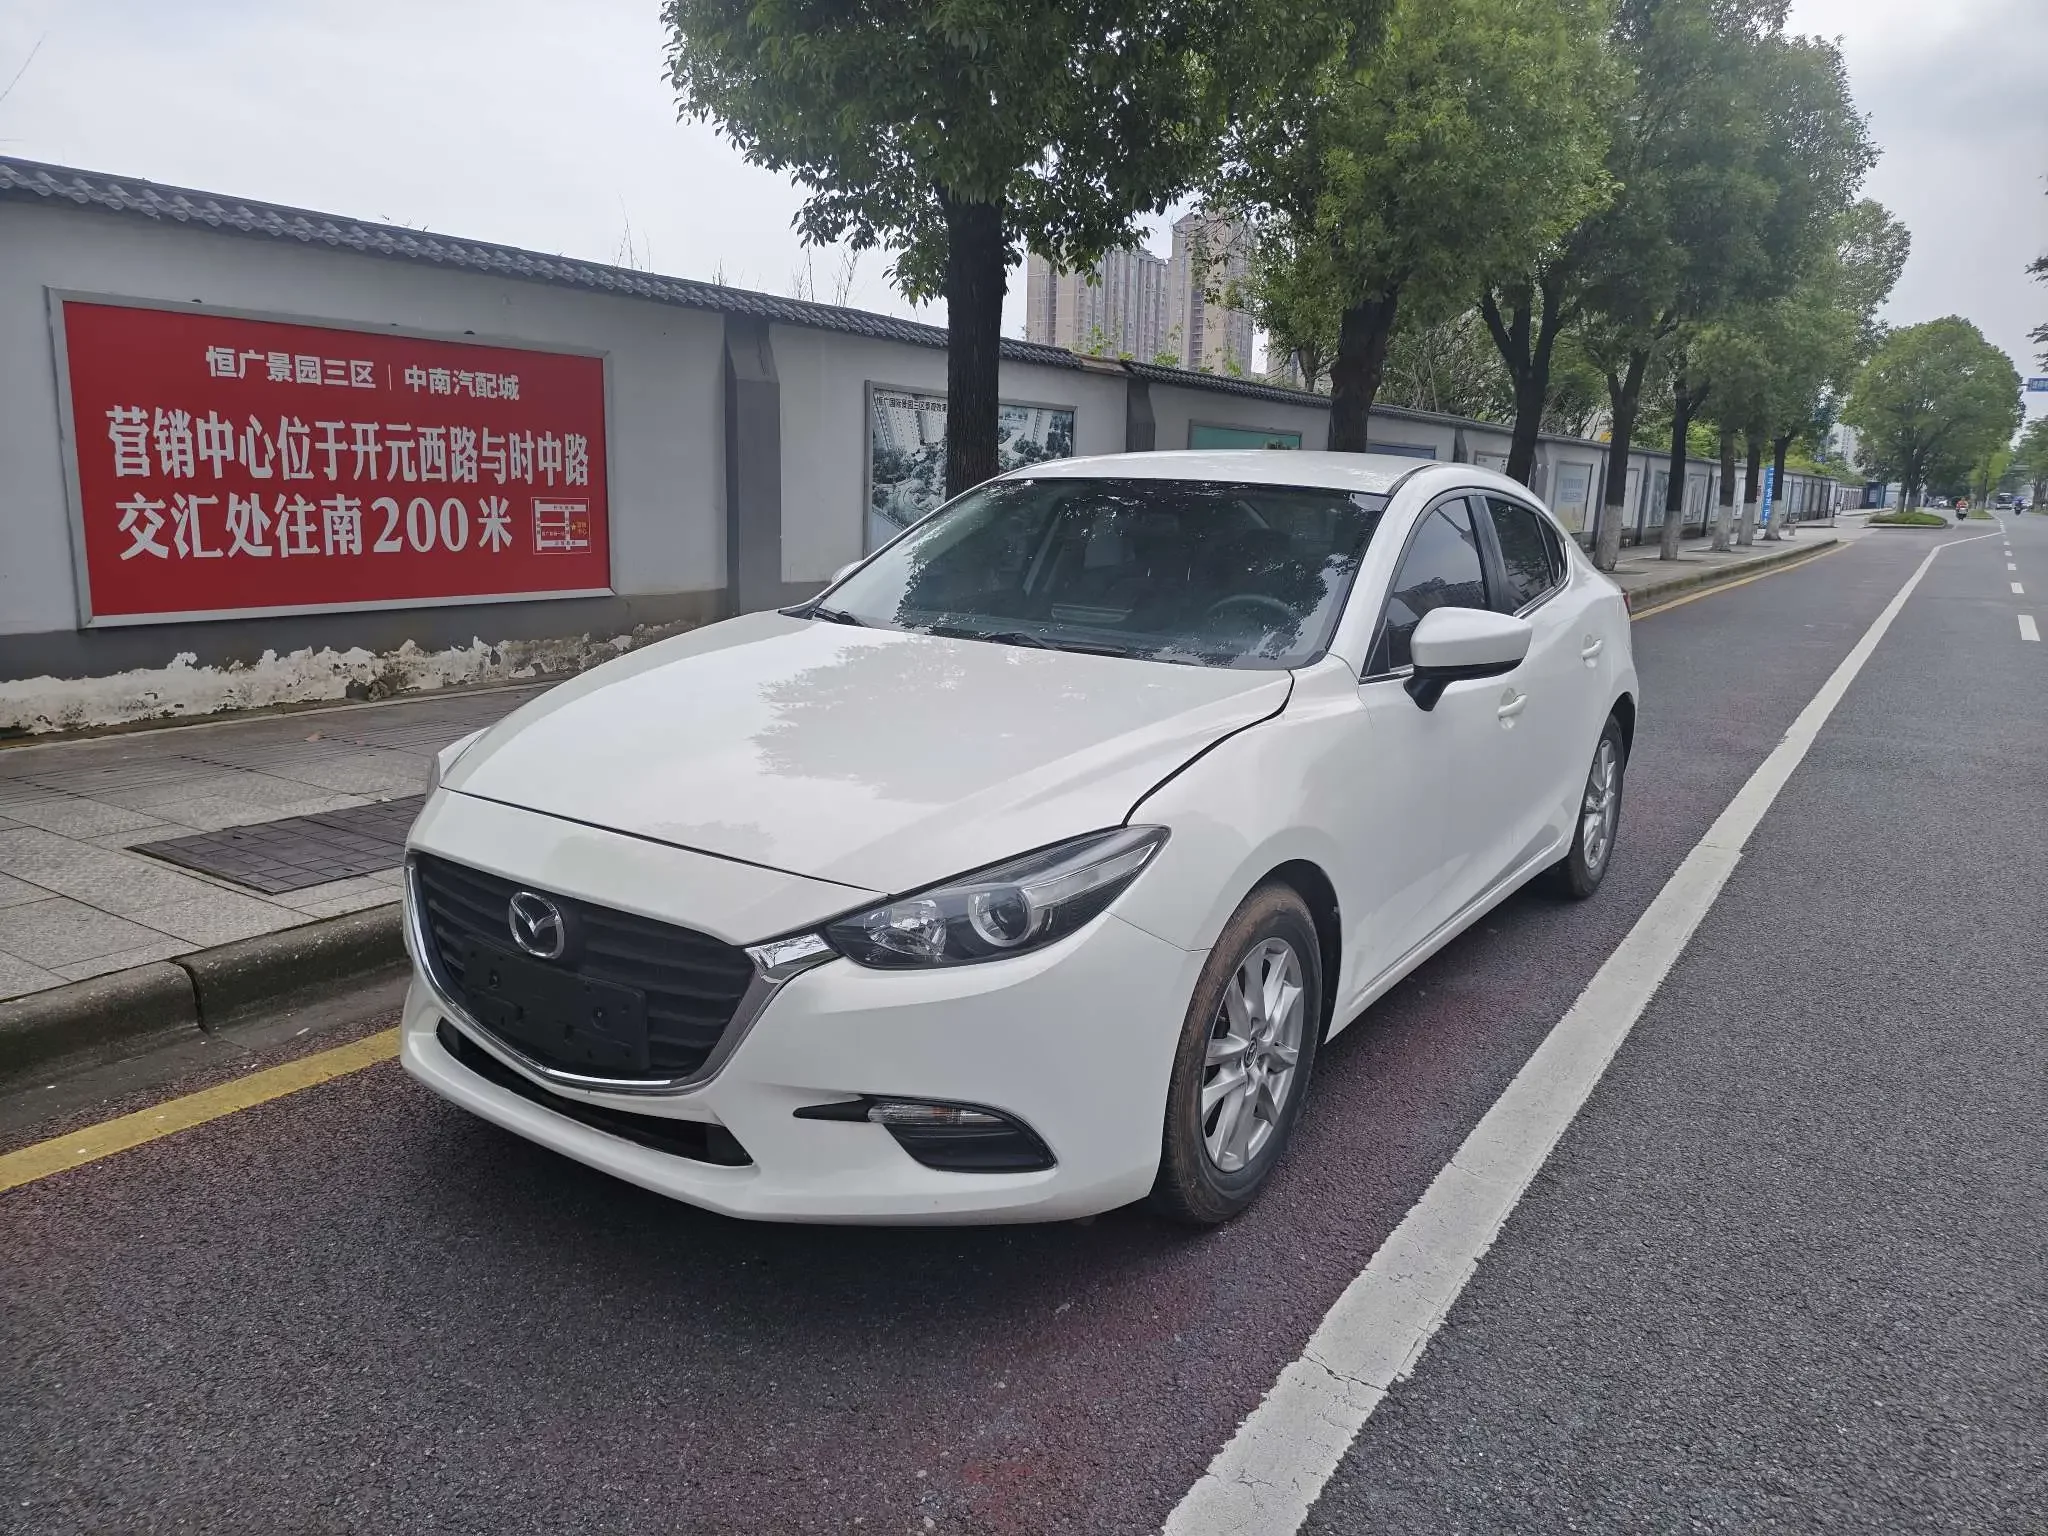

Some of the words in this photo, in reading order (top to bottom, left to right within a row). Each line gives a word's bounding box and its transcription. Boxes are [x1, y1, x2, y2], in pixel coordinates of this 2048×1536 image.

[205, 346, 376, 389] 恒广景园三区
[404, 364, 520, 401] 中南汽配城
[105, 405, 589, 486] 营销中心位于开元西路与时中路
[115, 491, 513, 561] 交汇处往南200米
